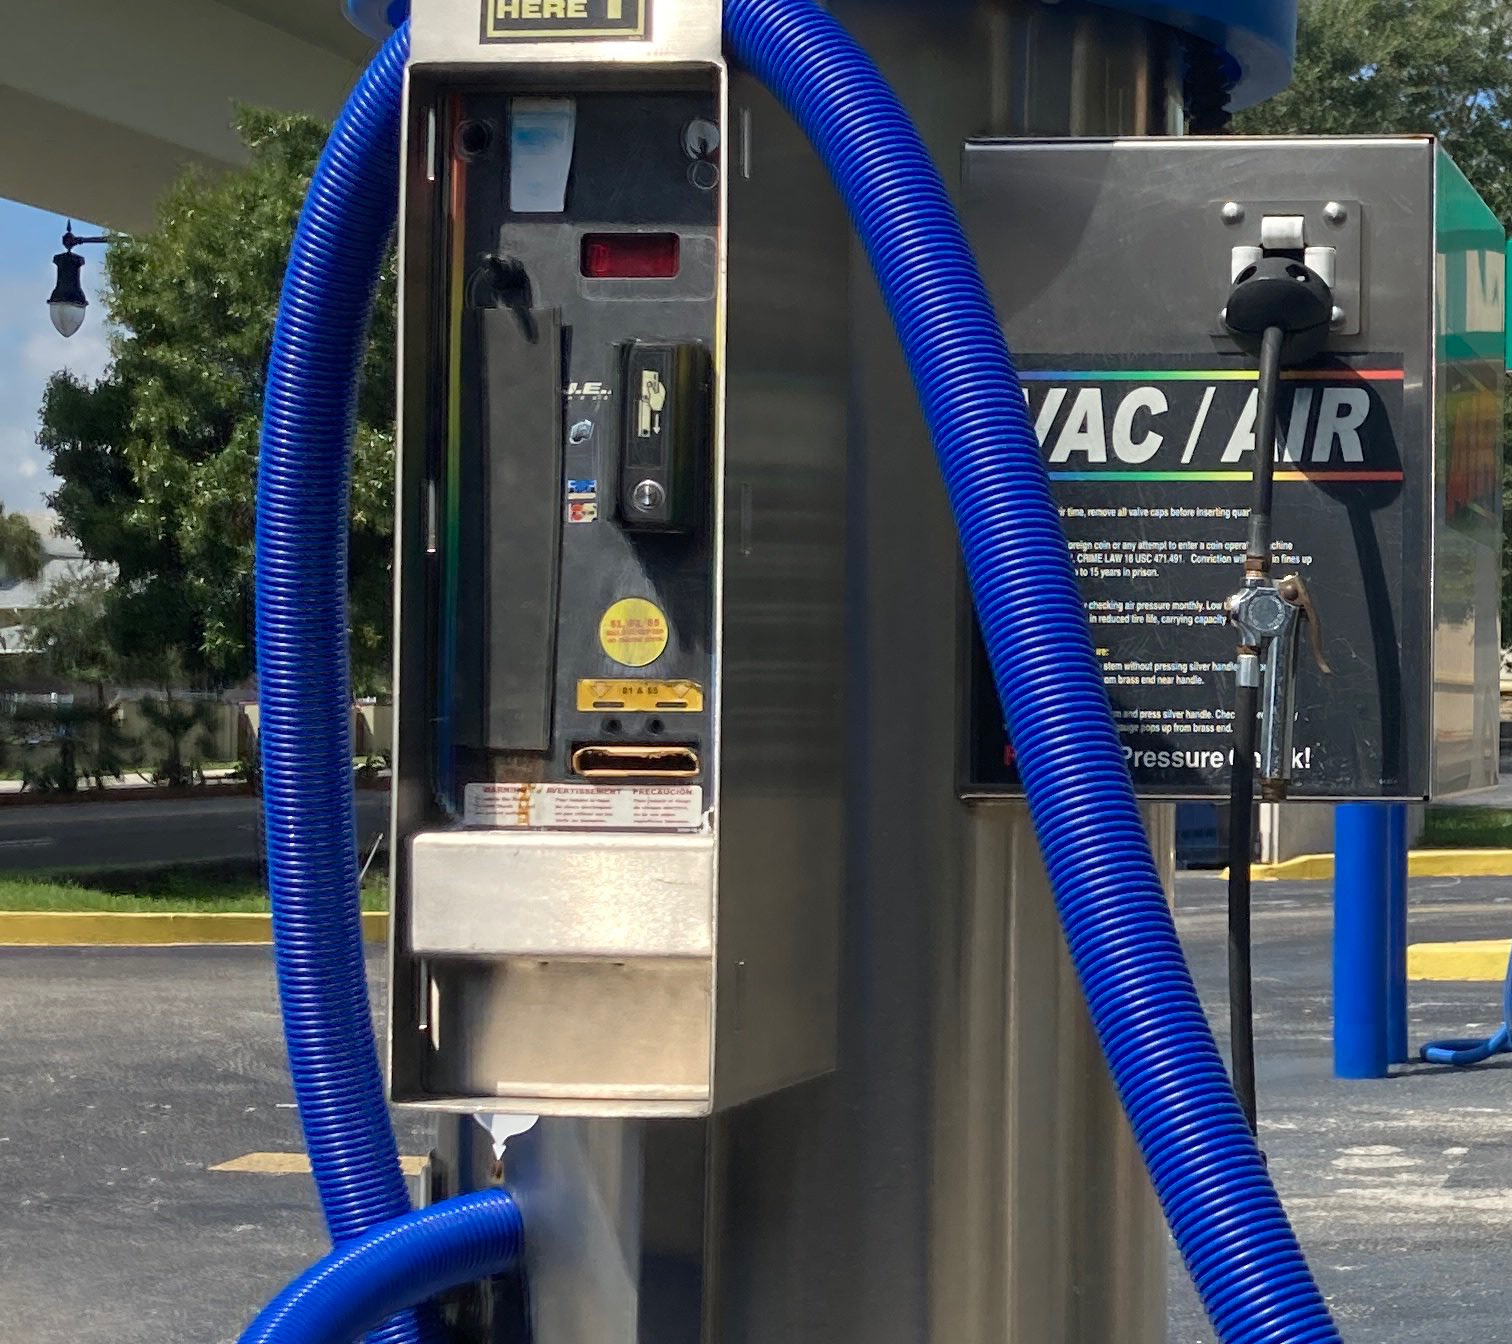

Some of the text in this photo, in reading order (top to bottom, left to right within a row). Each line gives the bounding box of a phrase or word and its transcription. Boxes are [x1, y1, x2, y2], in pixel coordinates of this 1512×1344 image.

[1220, 387, 1371, 463] AIR
[1067, 506, 1087, 518] time,
[1087, 508, 1116, 517] remove
[1117, 506, 1127, 517] all
[1128, 506, 1149, 517] valve
[1150, 508, 1169, 520] caps
[1170, 506, 1195, 517] before
[1196, 506, 1231, 520] inserting
[1067, 540, 1093, 552] oreign
[1094, 540, 1111, 550] coin
[1112, 542, 1121, 550] or
[1122, 542, 1137, 552] any
[1138, 540, 1167, 552] attempt
[1168, 541, 1177, 550] to
[1178, 541, 1199, 550] enter
[1199, 542, 1205, 550] a
[1206, 540, 1223, 550] coin
[1104, 553, 1123, 563] LAW
[1135, 553, 1153, 563] USC
[1190, 553, 1232, 563] Conviction
[1281, 553, 1300, 563] fines
[1301, 555, 1313, 565] up
[1079, 567, 1160, 579] to 15 years in prison.
[1088, 600, 1123, 612] checking
[1124, 600, 1136, 610] air
[1136, 602, 1171, 612] pressure
[1172, 600, 1205, 612] monthly.
[1206, 601, 1223, 610] Low
[1089, 614, 1098, 624] in
[1098, 614, 1130, 624] reduced
[1161, 614, 1194, 626] carrying
[1194, 614, 1227, 626] capacity
[1124, 661, 1153, 671] without
[1154, 661, 1188, 673] pressing
[1189, 661, 1210, 671] silver
[1117, 674, 1140, 684] brass
[1141, 675, 1156, 684] end
[1157, 676, 1174, 684] near
[1175, 674, 1205, 684] handle.
[1139, 711, 1162, 720] press
[1162, 709, 1185, 718] silver
[1185, 709, 1214, 719] handle.
[1215, 709, 1236, 719] Chec
[1161, 724, 1173, 734] up
[1173, 722, 1192, 732] from
[1192, 722, 1214, 732] brass
[1215, 722, 1233, 732] end.
[1121, 745, 1224, 768] Pressure
